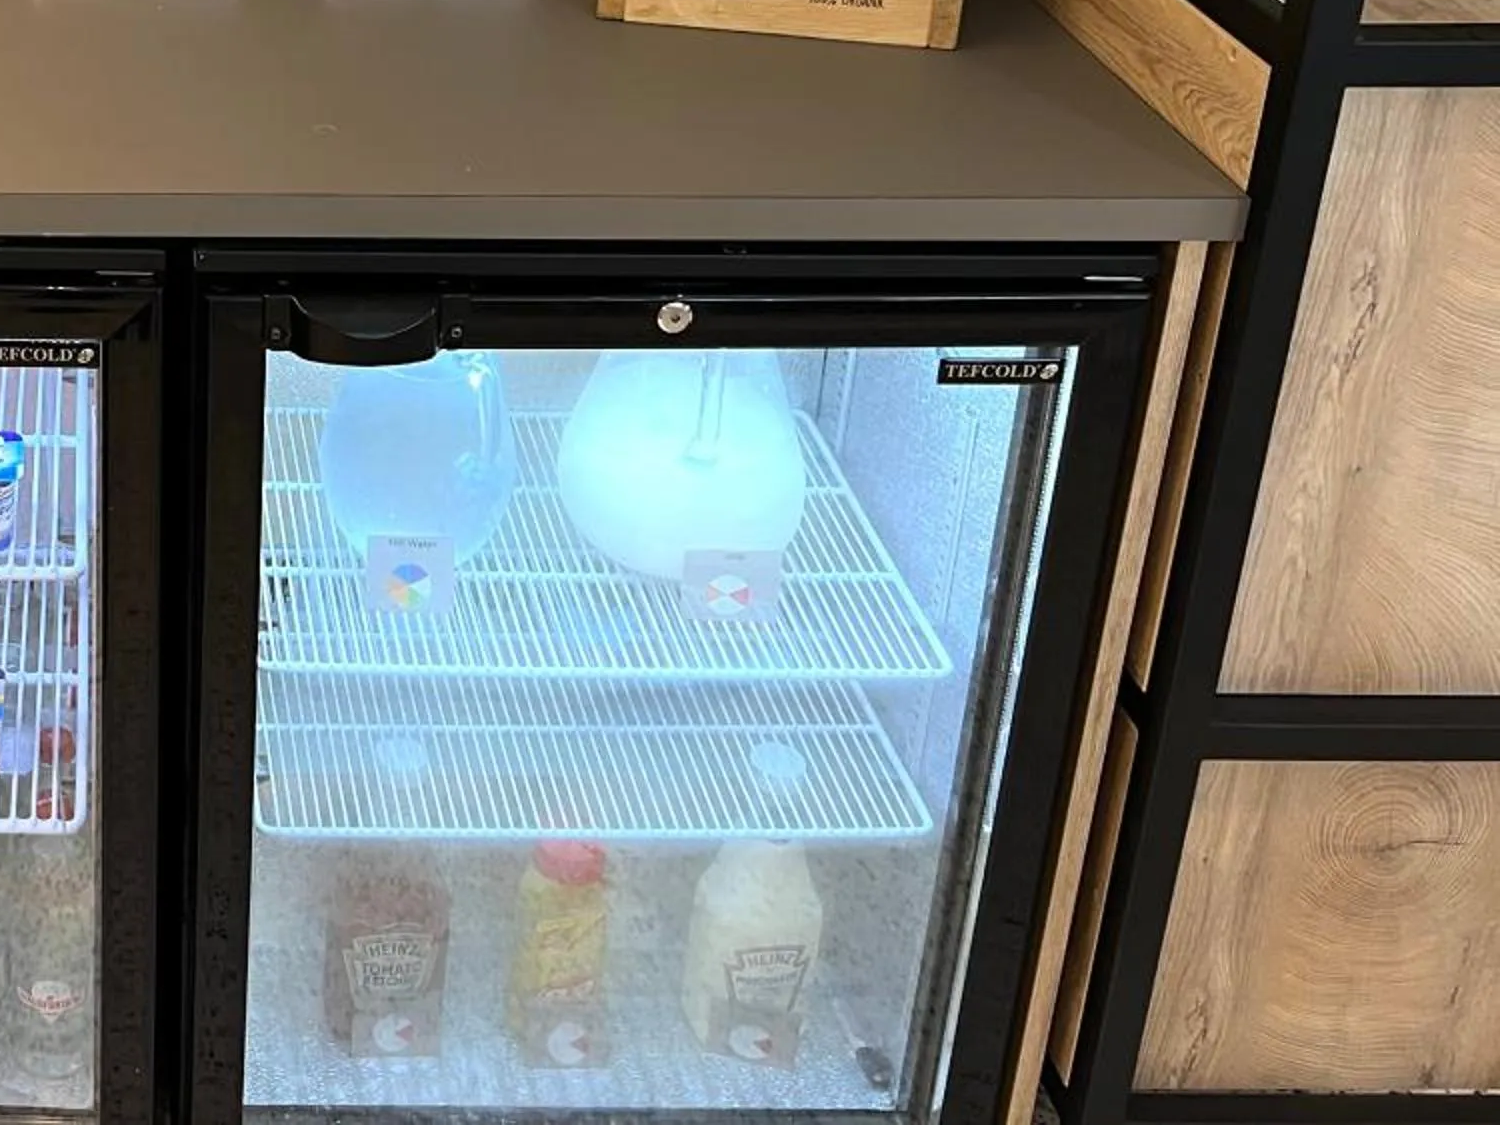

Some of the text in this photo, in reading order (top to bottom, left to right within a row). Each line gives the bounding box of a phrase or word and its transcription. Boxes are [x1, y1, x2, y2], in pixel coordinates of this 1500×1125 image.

[945, 363, 1038, 378] TEFCOLD
[362, 942, 420, 957] HEINZ
[362, 961, 422, 976] TOMATO
